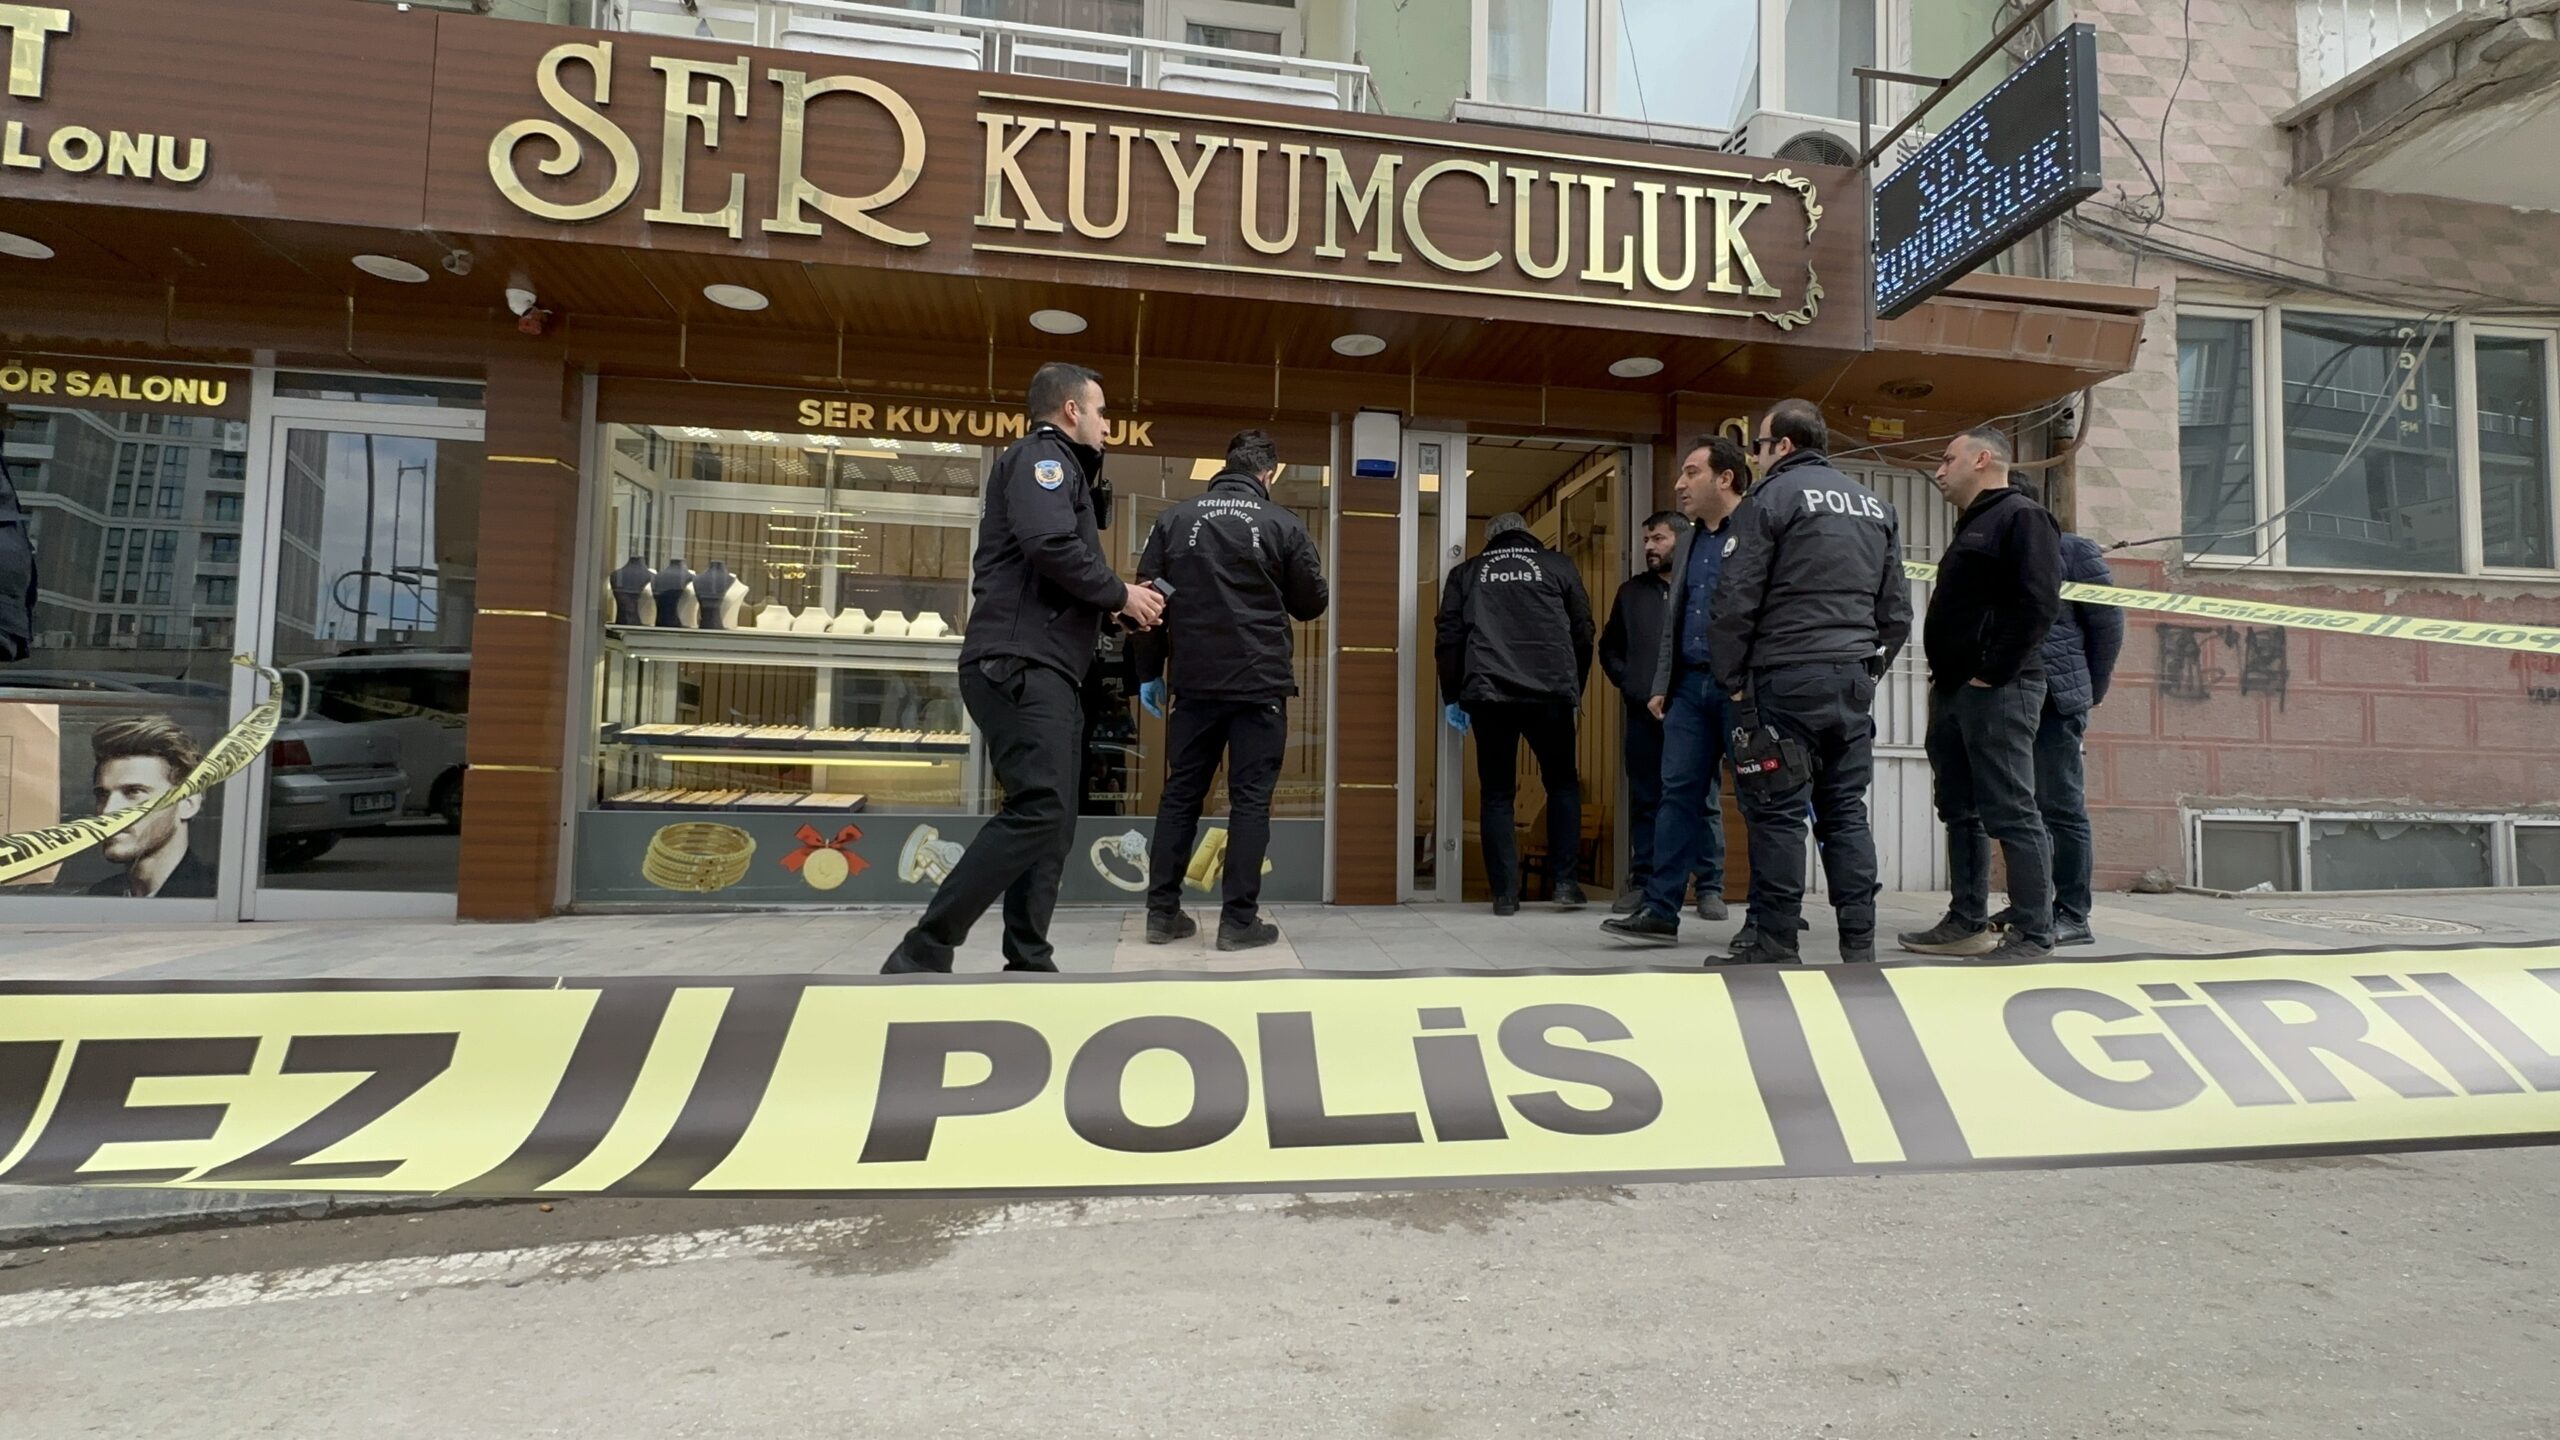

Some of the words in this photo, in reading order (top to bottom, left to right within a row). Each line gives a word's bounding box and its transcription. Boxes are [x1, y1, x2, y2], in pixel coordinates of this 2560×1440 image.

[0, 3, 71, 98] T
[488, 40, 931, 247] SER
[973, 112, 1782, 298] KUYUMCULUK
[1918, 115, 1995, 221] SER
[66, 370, 227, 406] SALONU
[798, 399, 874, 429] SER
